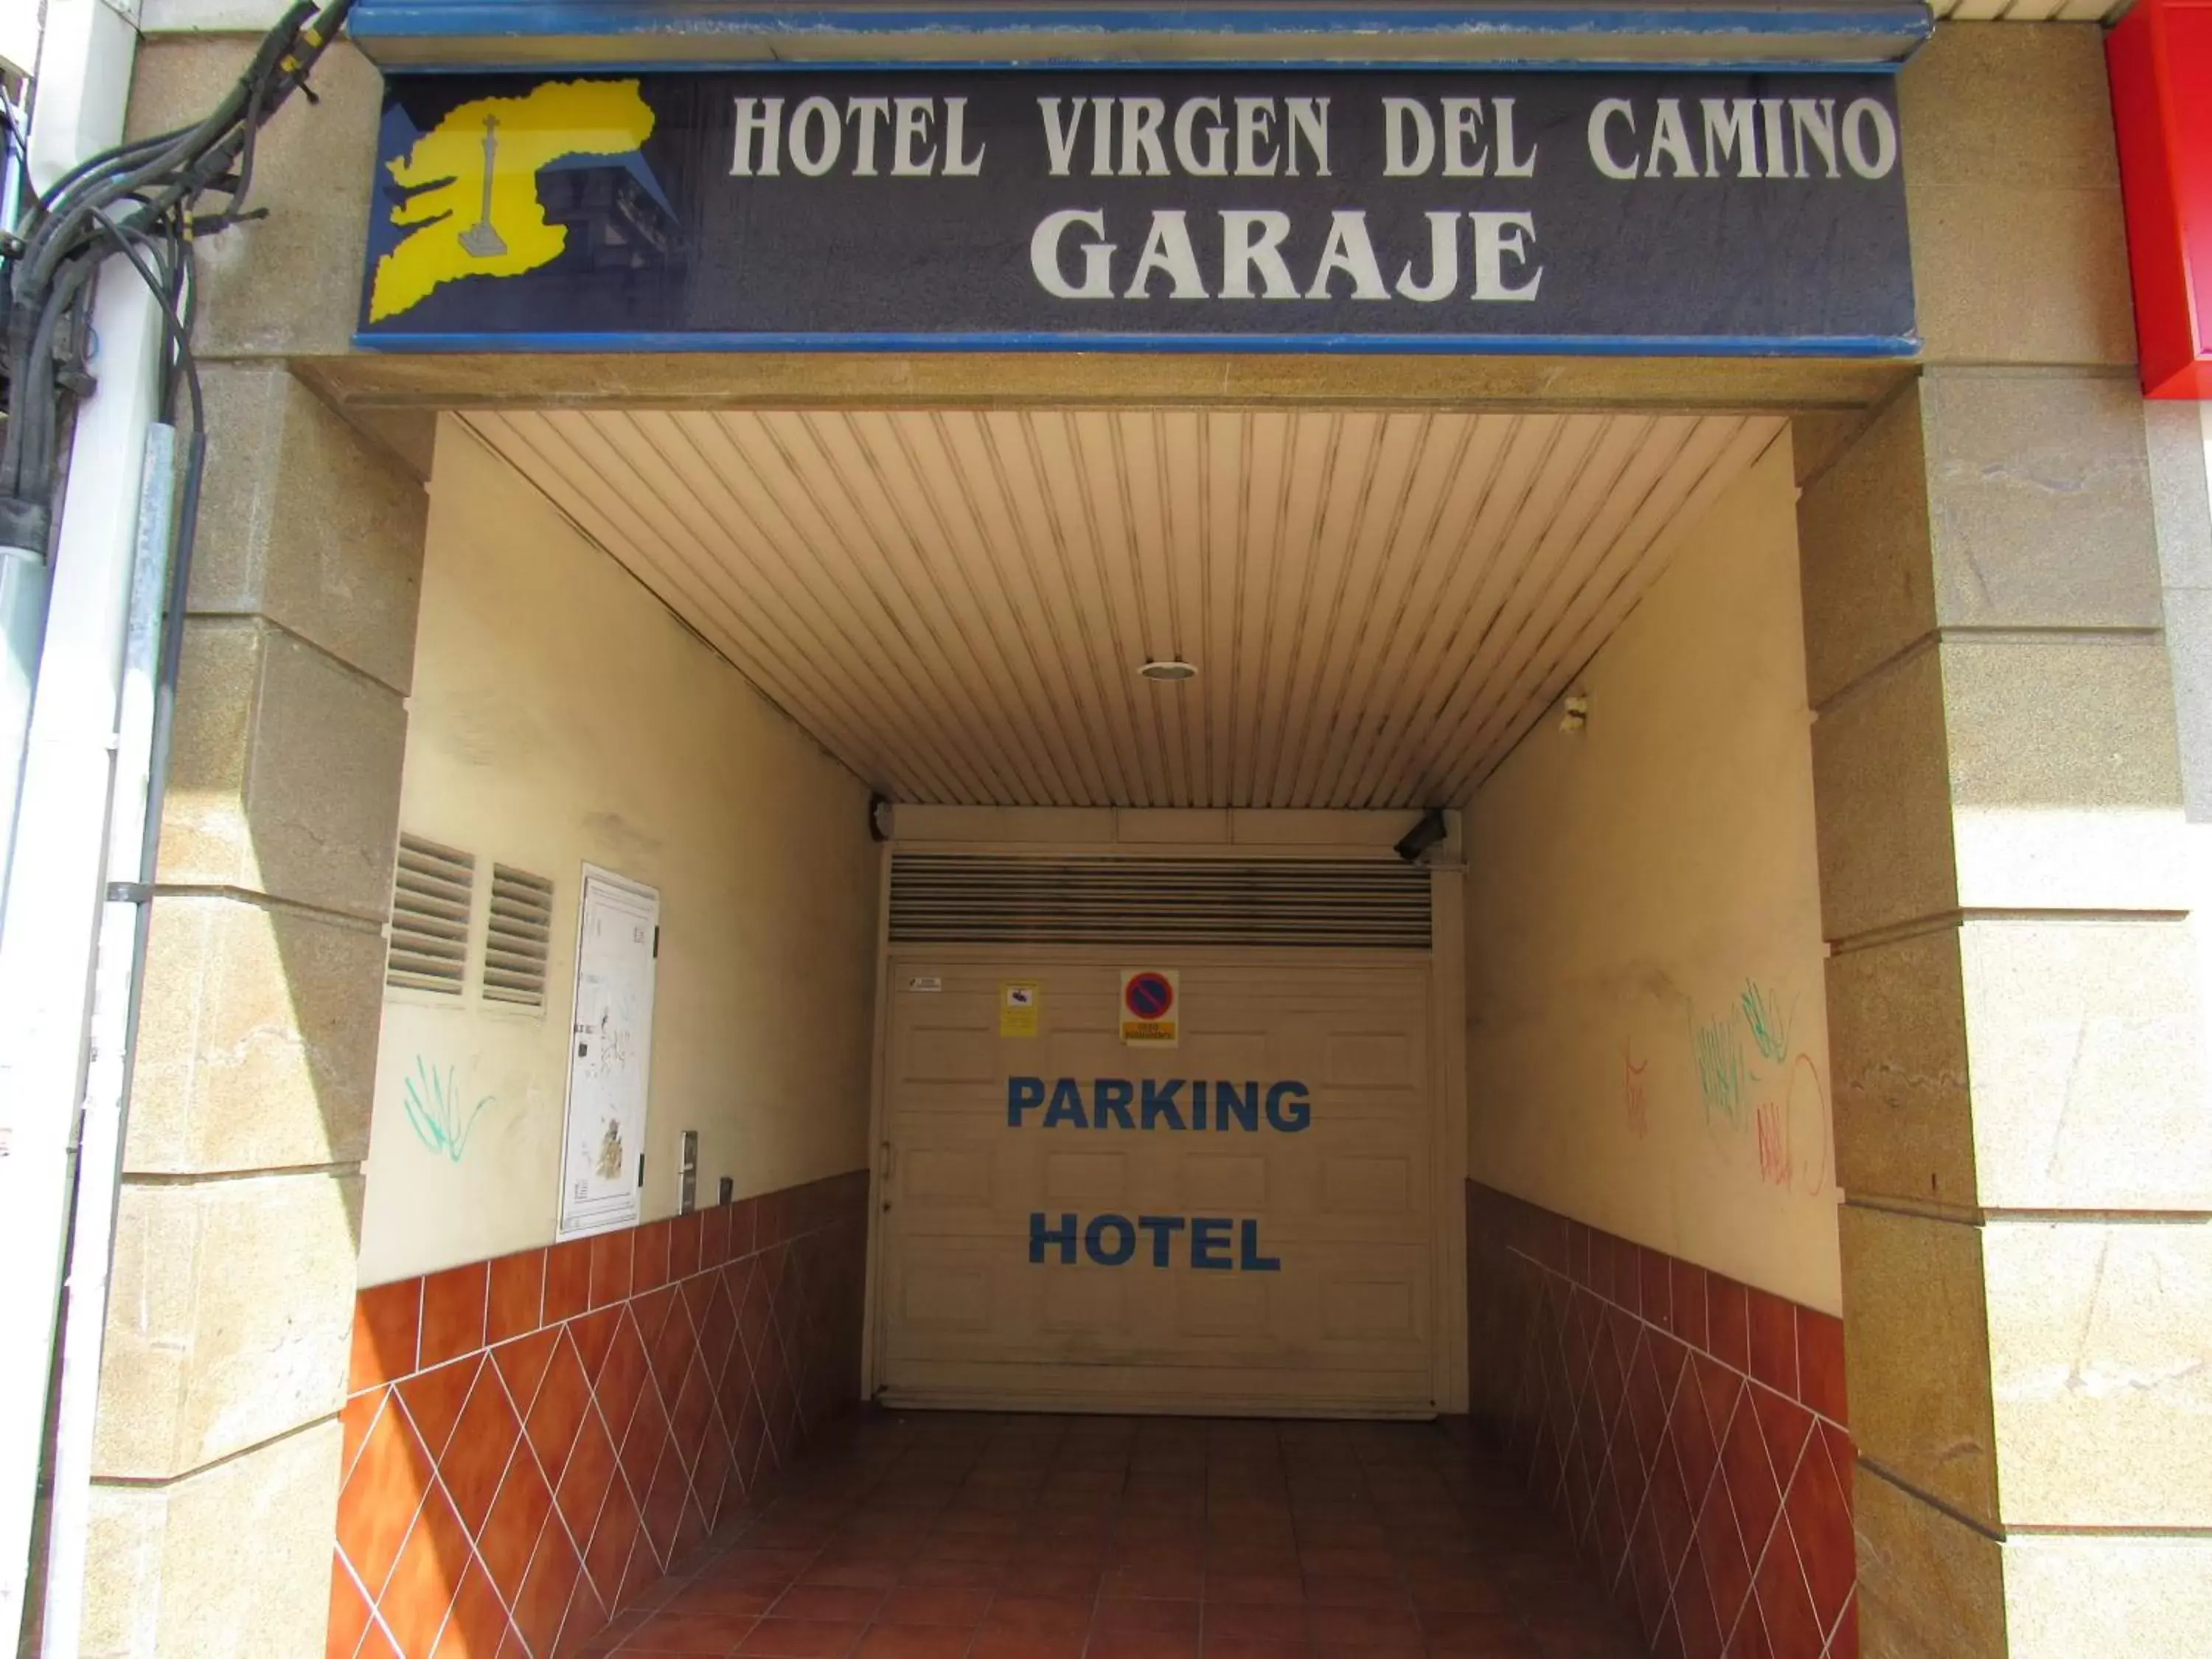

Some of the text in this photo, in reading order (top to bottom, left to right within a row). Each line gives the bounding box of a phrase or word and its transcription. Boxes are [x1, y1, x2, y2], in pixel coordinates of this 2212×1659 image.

[728, 97, 1897, 181] HOTEL VIRGEN DEL CAMINO
[1029, 208, 1544, 303] GARAJE
[1007, 1076, 1311, 1133] PARKING
[1028, 1212, 1281, 1271] HOTEL
